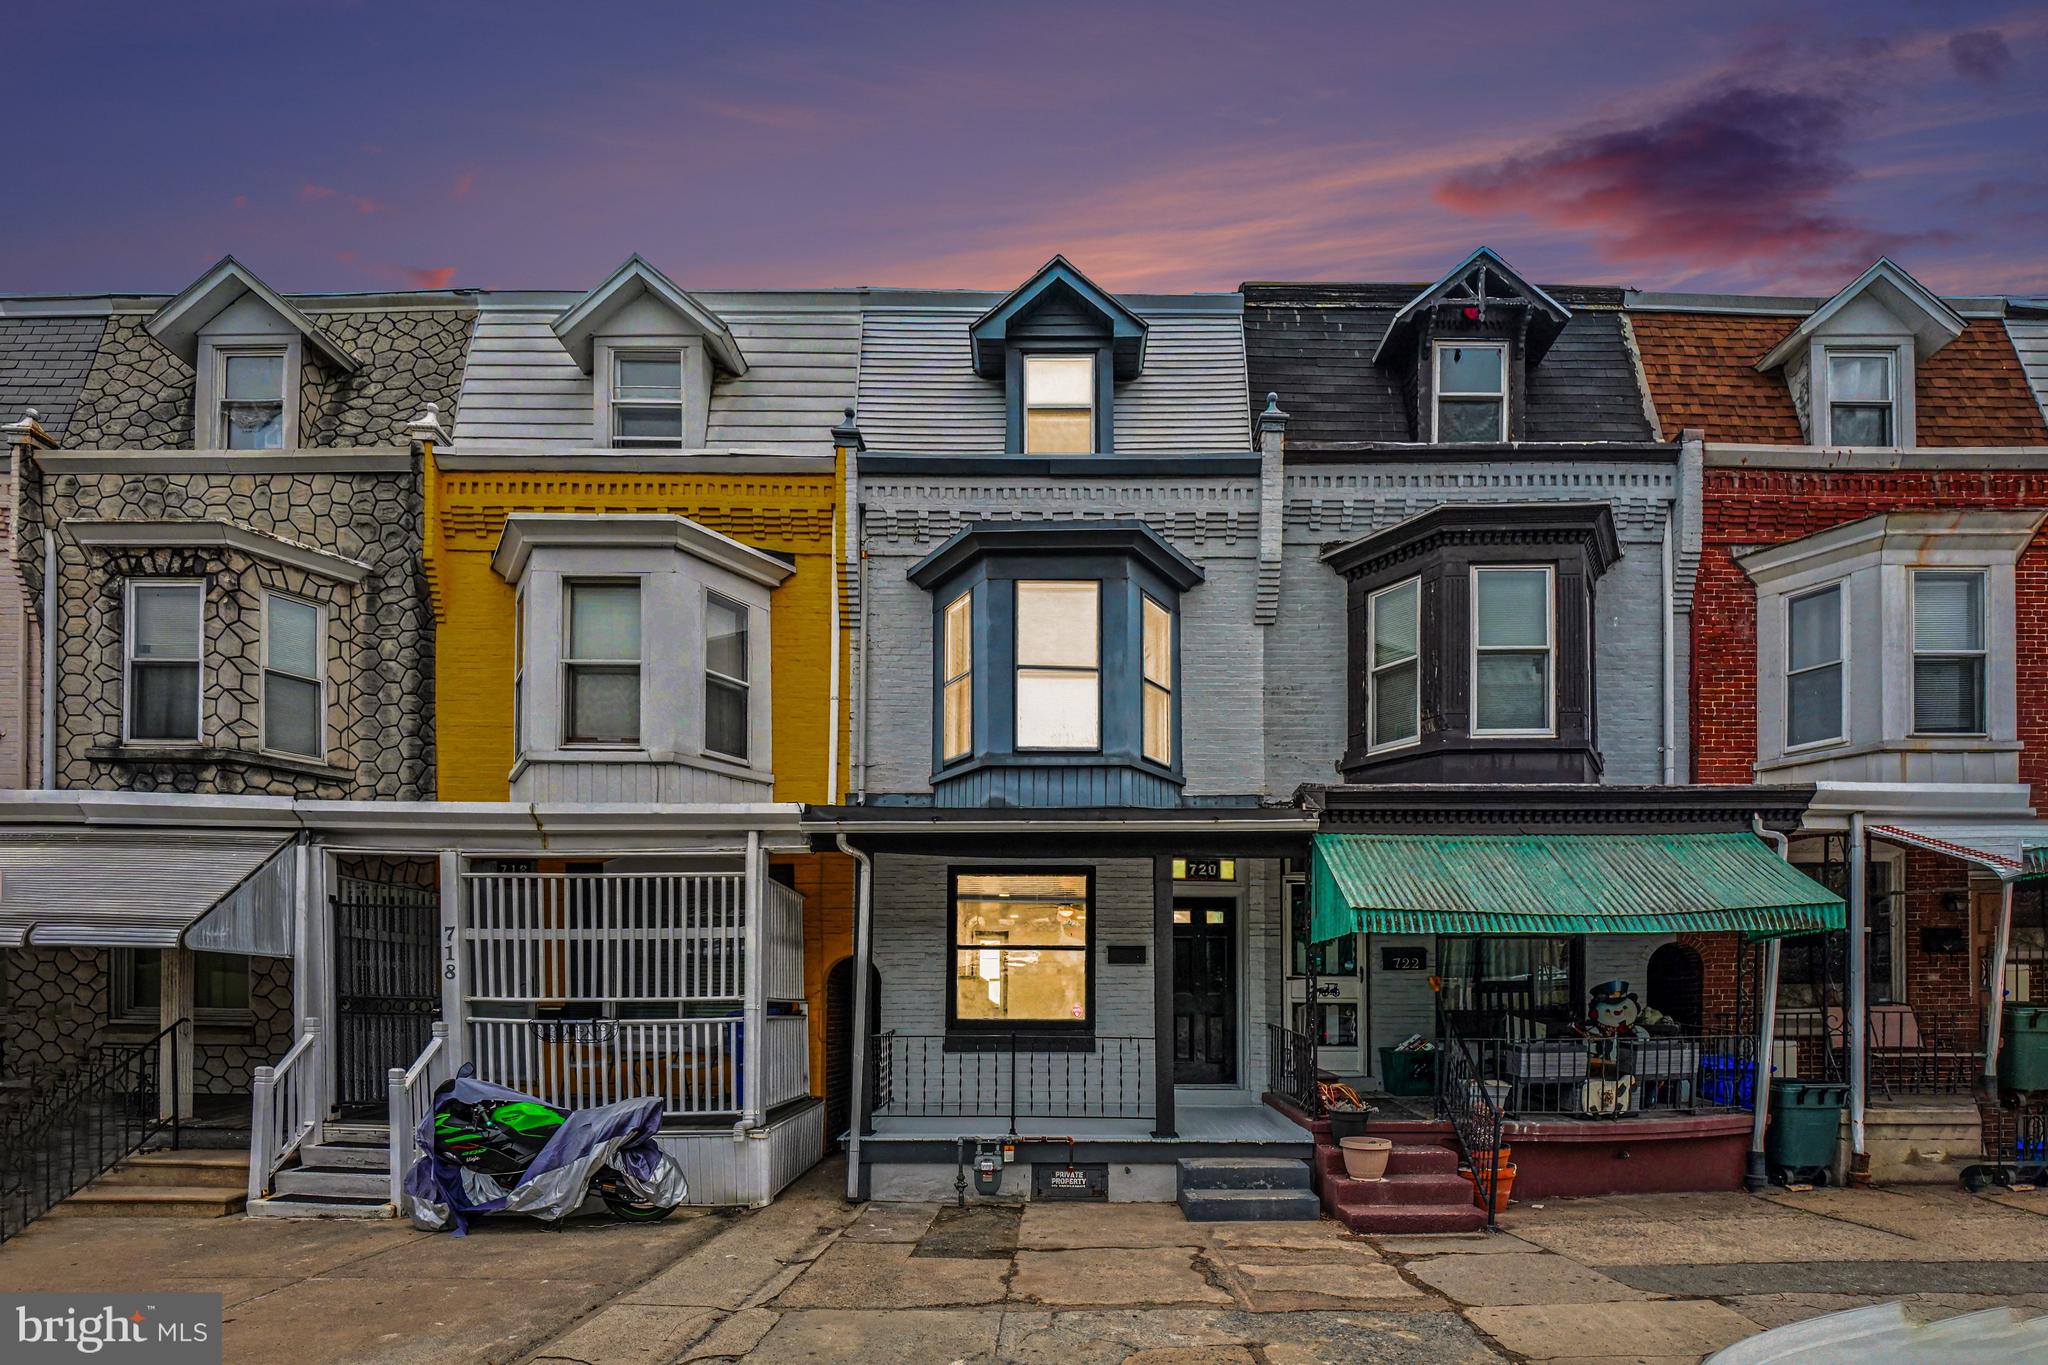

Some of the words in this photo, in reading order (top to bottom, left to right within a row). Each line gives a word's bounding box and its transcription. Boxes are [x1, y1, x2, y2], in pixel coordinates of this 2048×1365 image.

[1189, 864, 1216, 875] 720
[444, 926, 456, 980] 718
[1392, 957, 1419, 969] 722
